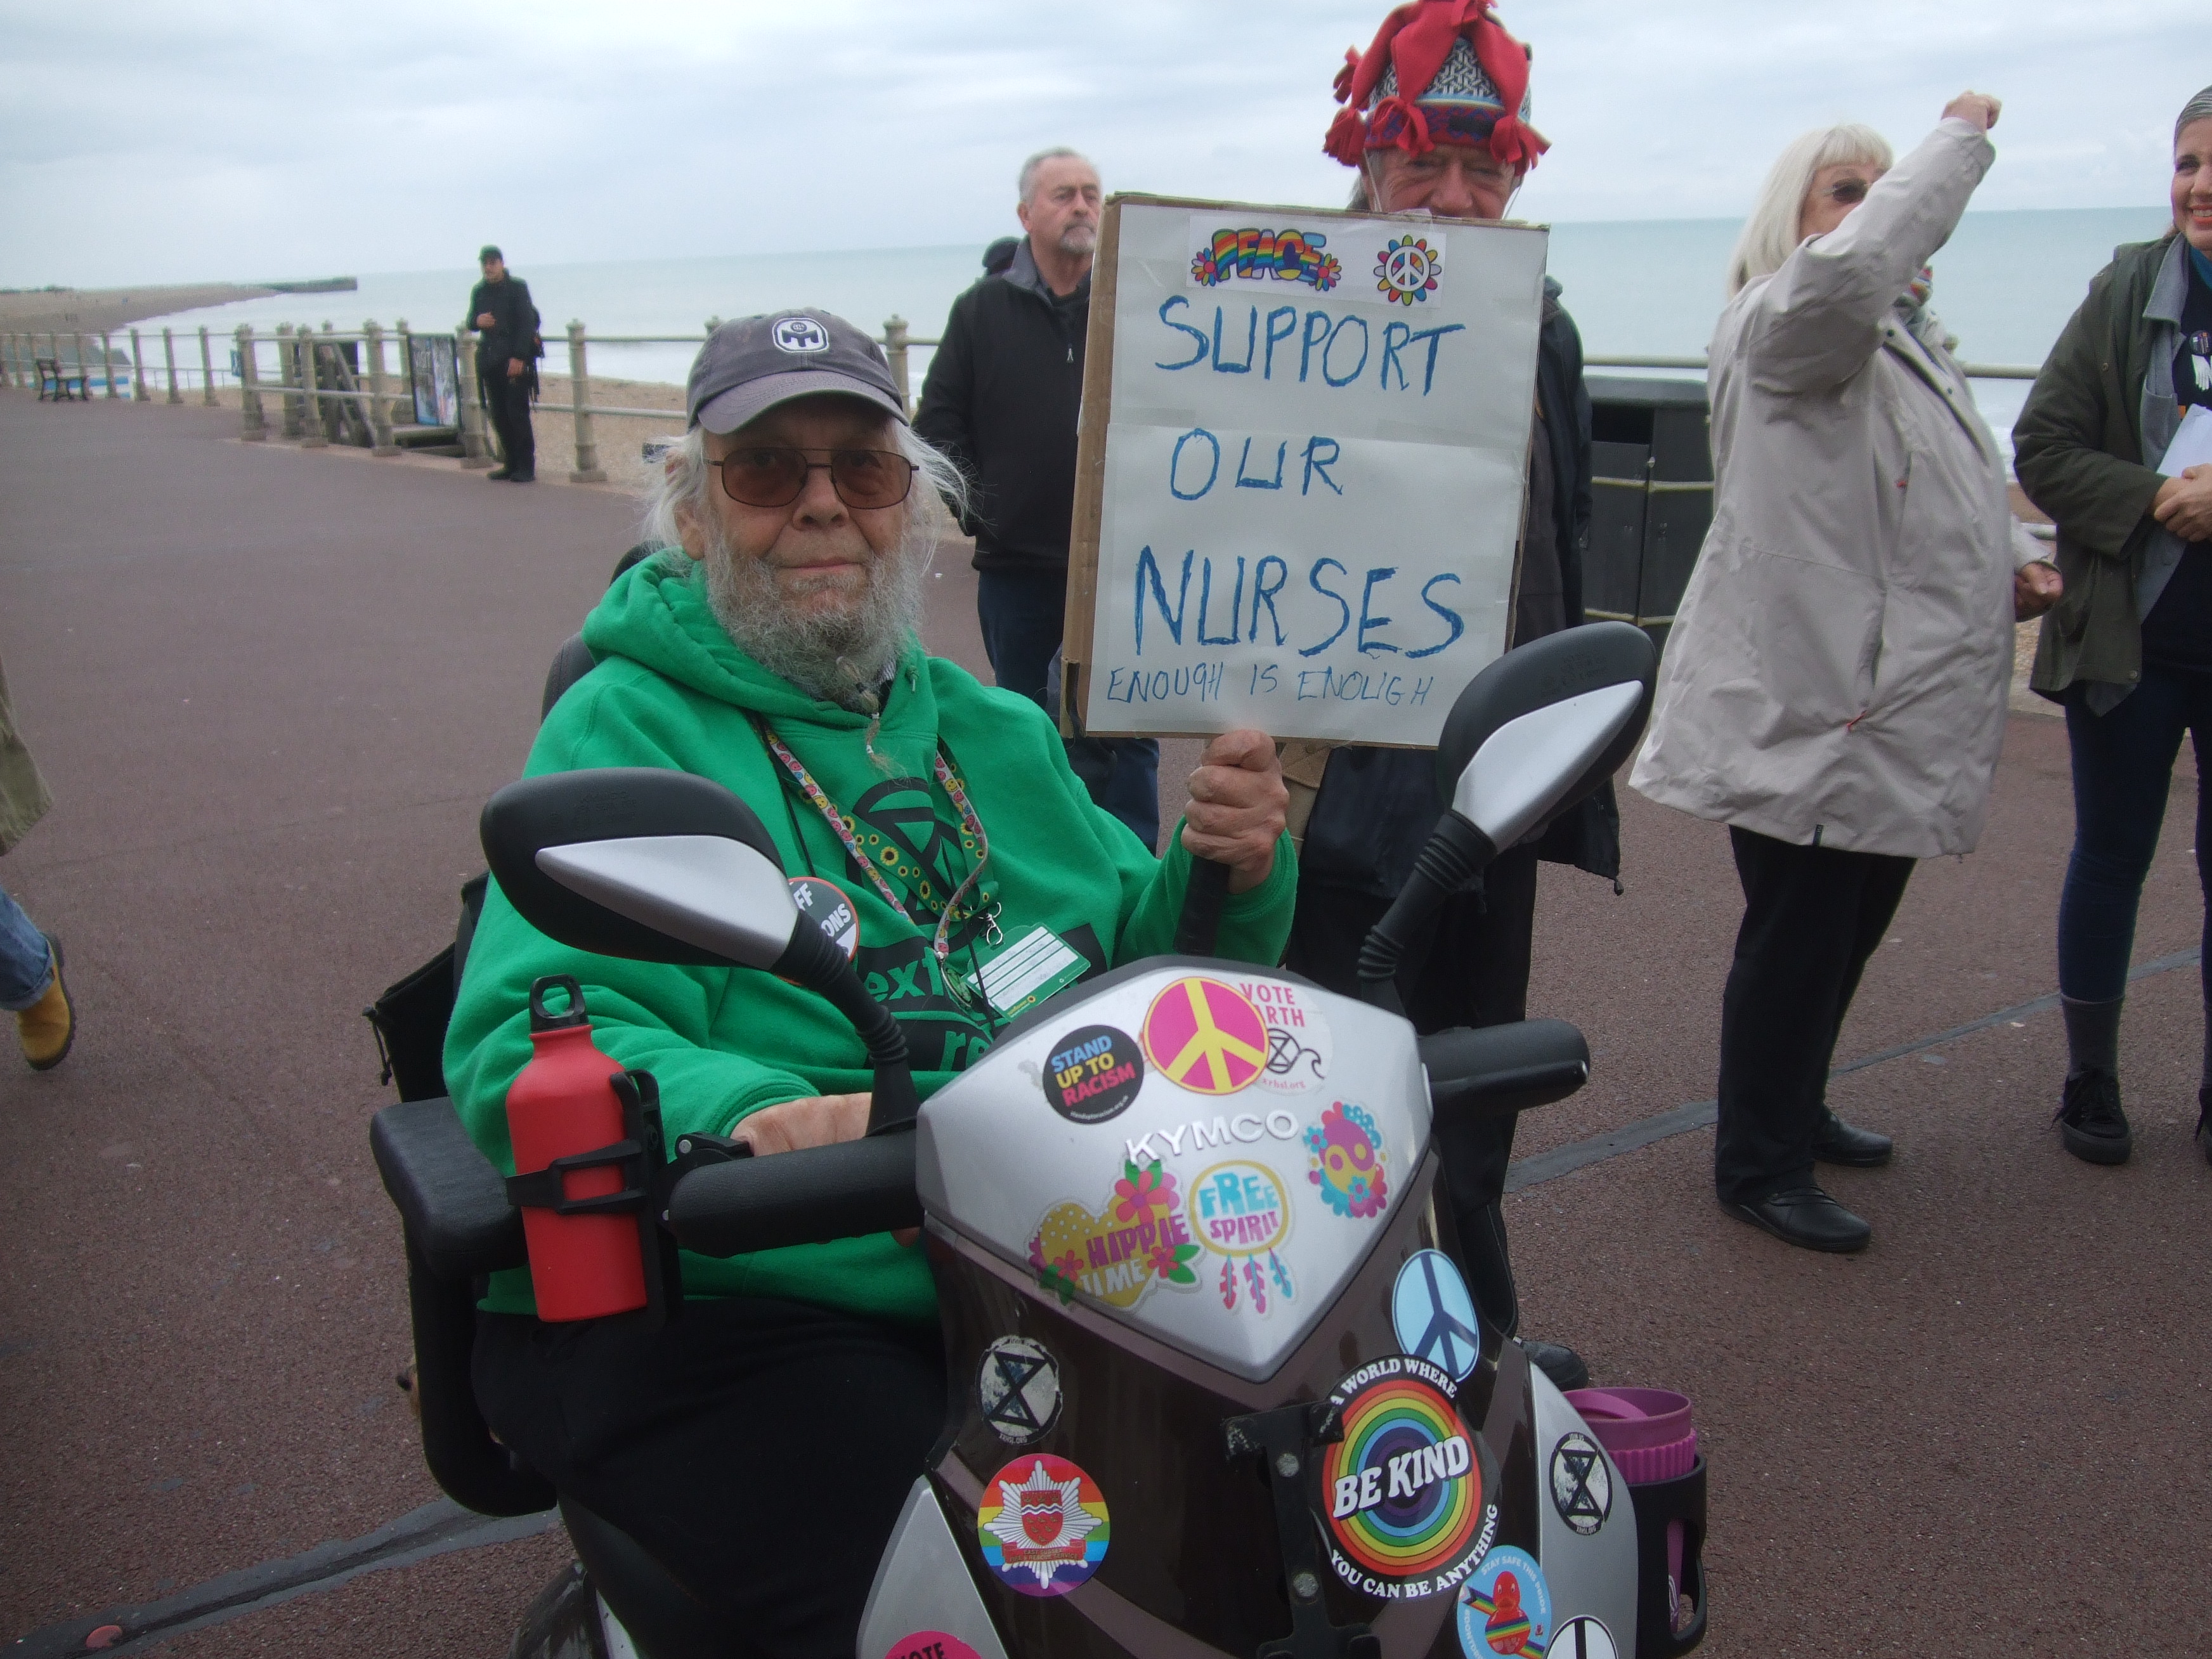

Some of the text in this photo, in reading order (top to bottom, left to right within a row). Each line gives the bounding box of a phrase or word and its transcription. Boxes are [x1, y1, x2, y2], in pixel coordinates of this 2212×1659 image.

[1212, 228, 1327, 283] PEACE
[1155, 294, 1466, 396] SUPPORT
[1169, 428, 1343, 500] OUR
[1135, 545, 1464, 658] NURSES
[1250, 663, 1278, 694] IS
[1297, 666, 1435, 706] ENOUGH
[793, 882, 814, 911] FF
[1239, 982, 1295, 1005] VOTE
[1254, 1004, 1306, 1028] RTH
[1051, 1035, 1113, 1073] STAND
[1055, 1052, 1115, 1089] UP TO
[1062, 1061, 1136, 1107] RACISM
[1125, 1110, 1299, 1167] KYMCO
[1199, 1172, 1279, 1220] FREE
[1086, 1213, 1190, 1269] HIPPIE
[1209, 1211, 1279, 1245] SPIRIT
[1079, 1258, 1146, 1297] TIME
[1341, 1358, 1402, 1394] WORLD
[1403, 1358, 1457, 1399] WHERE
[1333, 1435, 1470, 1518] BE KIND
[1332, 1504, 1498, 1597] YOU CAN BE ANYTHING
[1481, 1556, 1547, 1615] STAY SAFE THIS PRIDE
[895, 1642, 947, 1659] OTE
